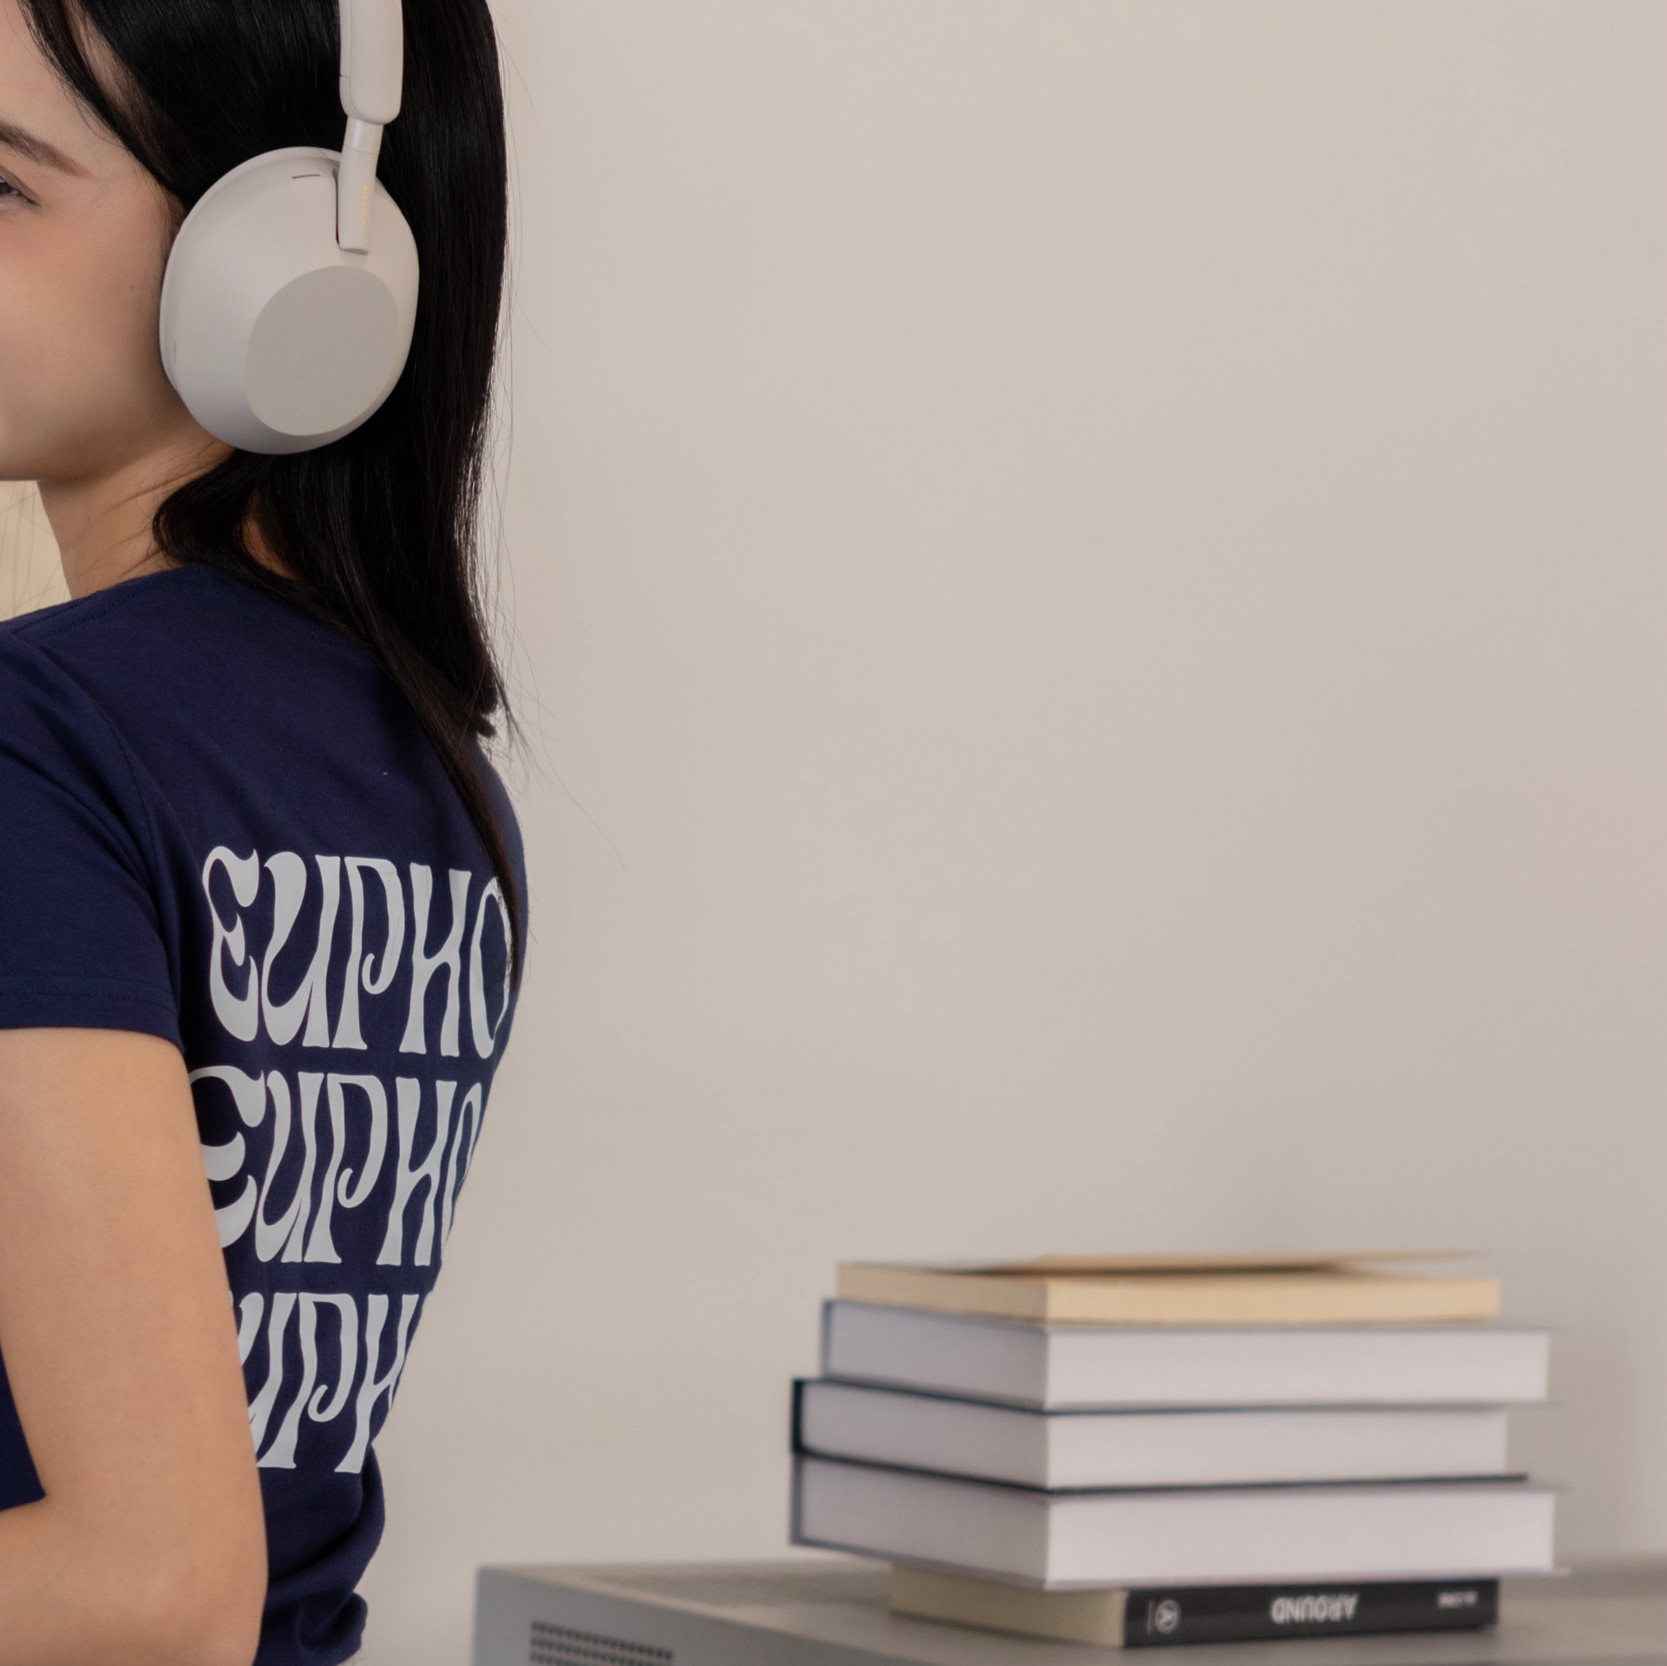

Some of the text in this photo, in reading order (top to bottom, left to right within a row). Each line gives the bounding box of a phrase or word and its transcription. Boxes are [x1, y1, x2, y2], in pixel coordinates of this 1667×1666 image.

[202, 845, 512, 1059] EUPHO
[229, 1290, 419, 1474] UPH
[1270, 1592, 1359, 1624] AROUND
